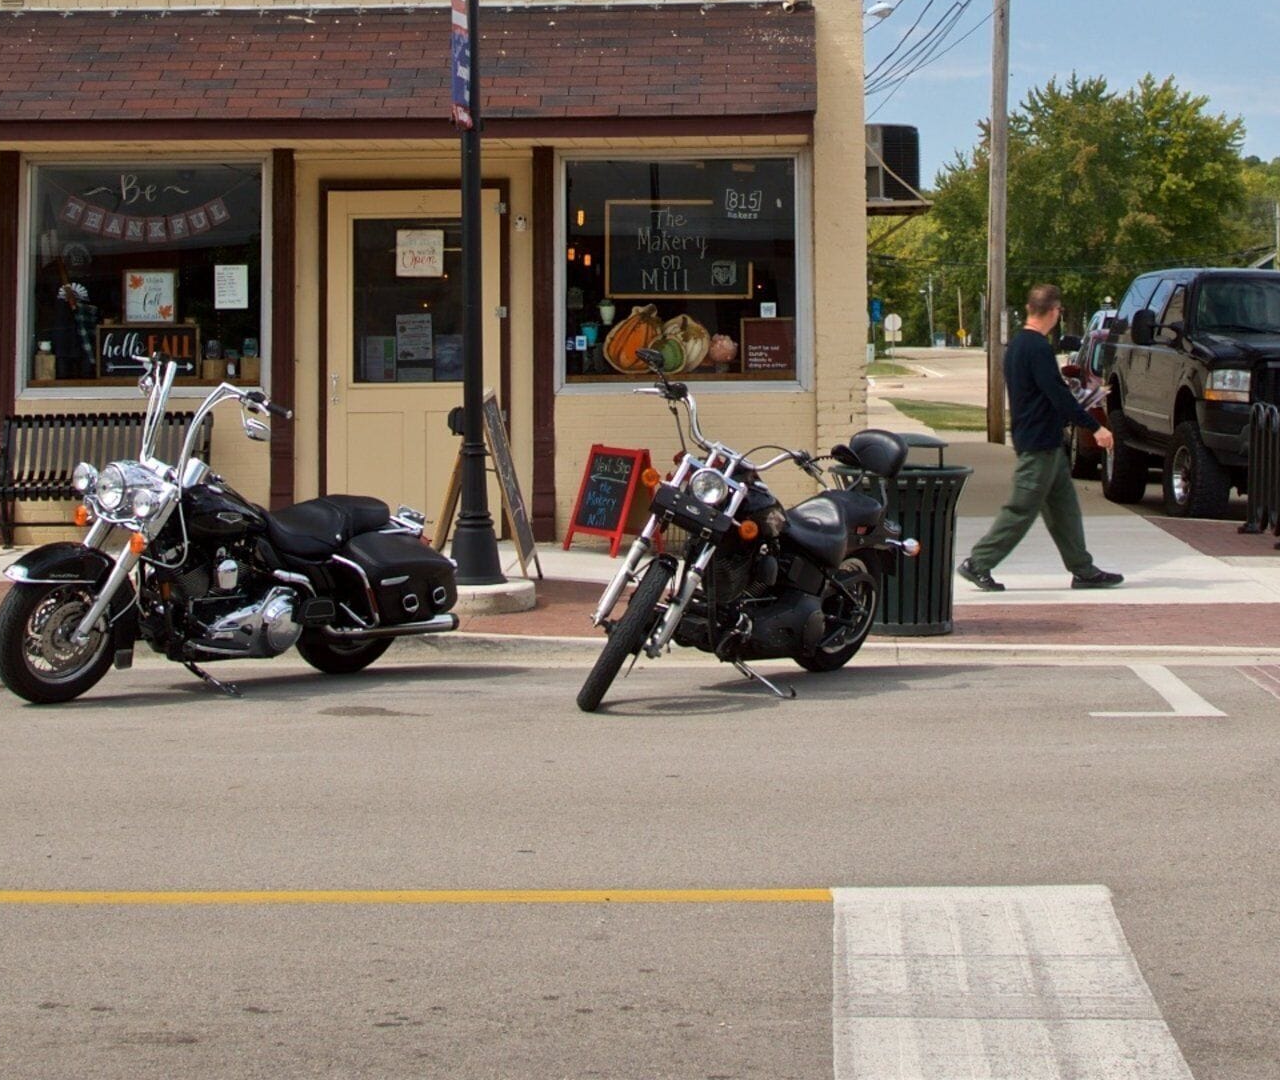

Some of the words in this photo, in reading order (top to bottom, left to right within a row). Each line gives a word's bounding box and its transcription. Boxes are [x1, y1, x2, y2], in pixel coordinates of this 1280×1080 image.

[121, 174, 158, 204] Be
[64, 201, 227, 239] THANKFUL
[650, 206, 688, 230] The
[637, 225, 709, 260] Makery
[660, 254, 682, 270] on
[641, 268, 690, 292] Mill
[142, 292, 162, 312] fall
[102, 332, 147, 358] hello
[148, 335, 193, 359] FALL
